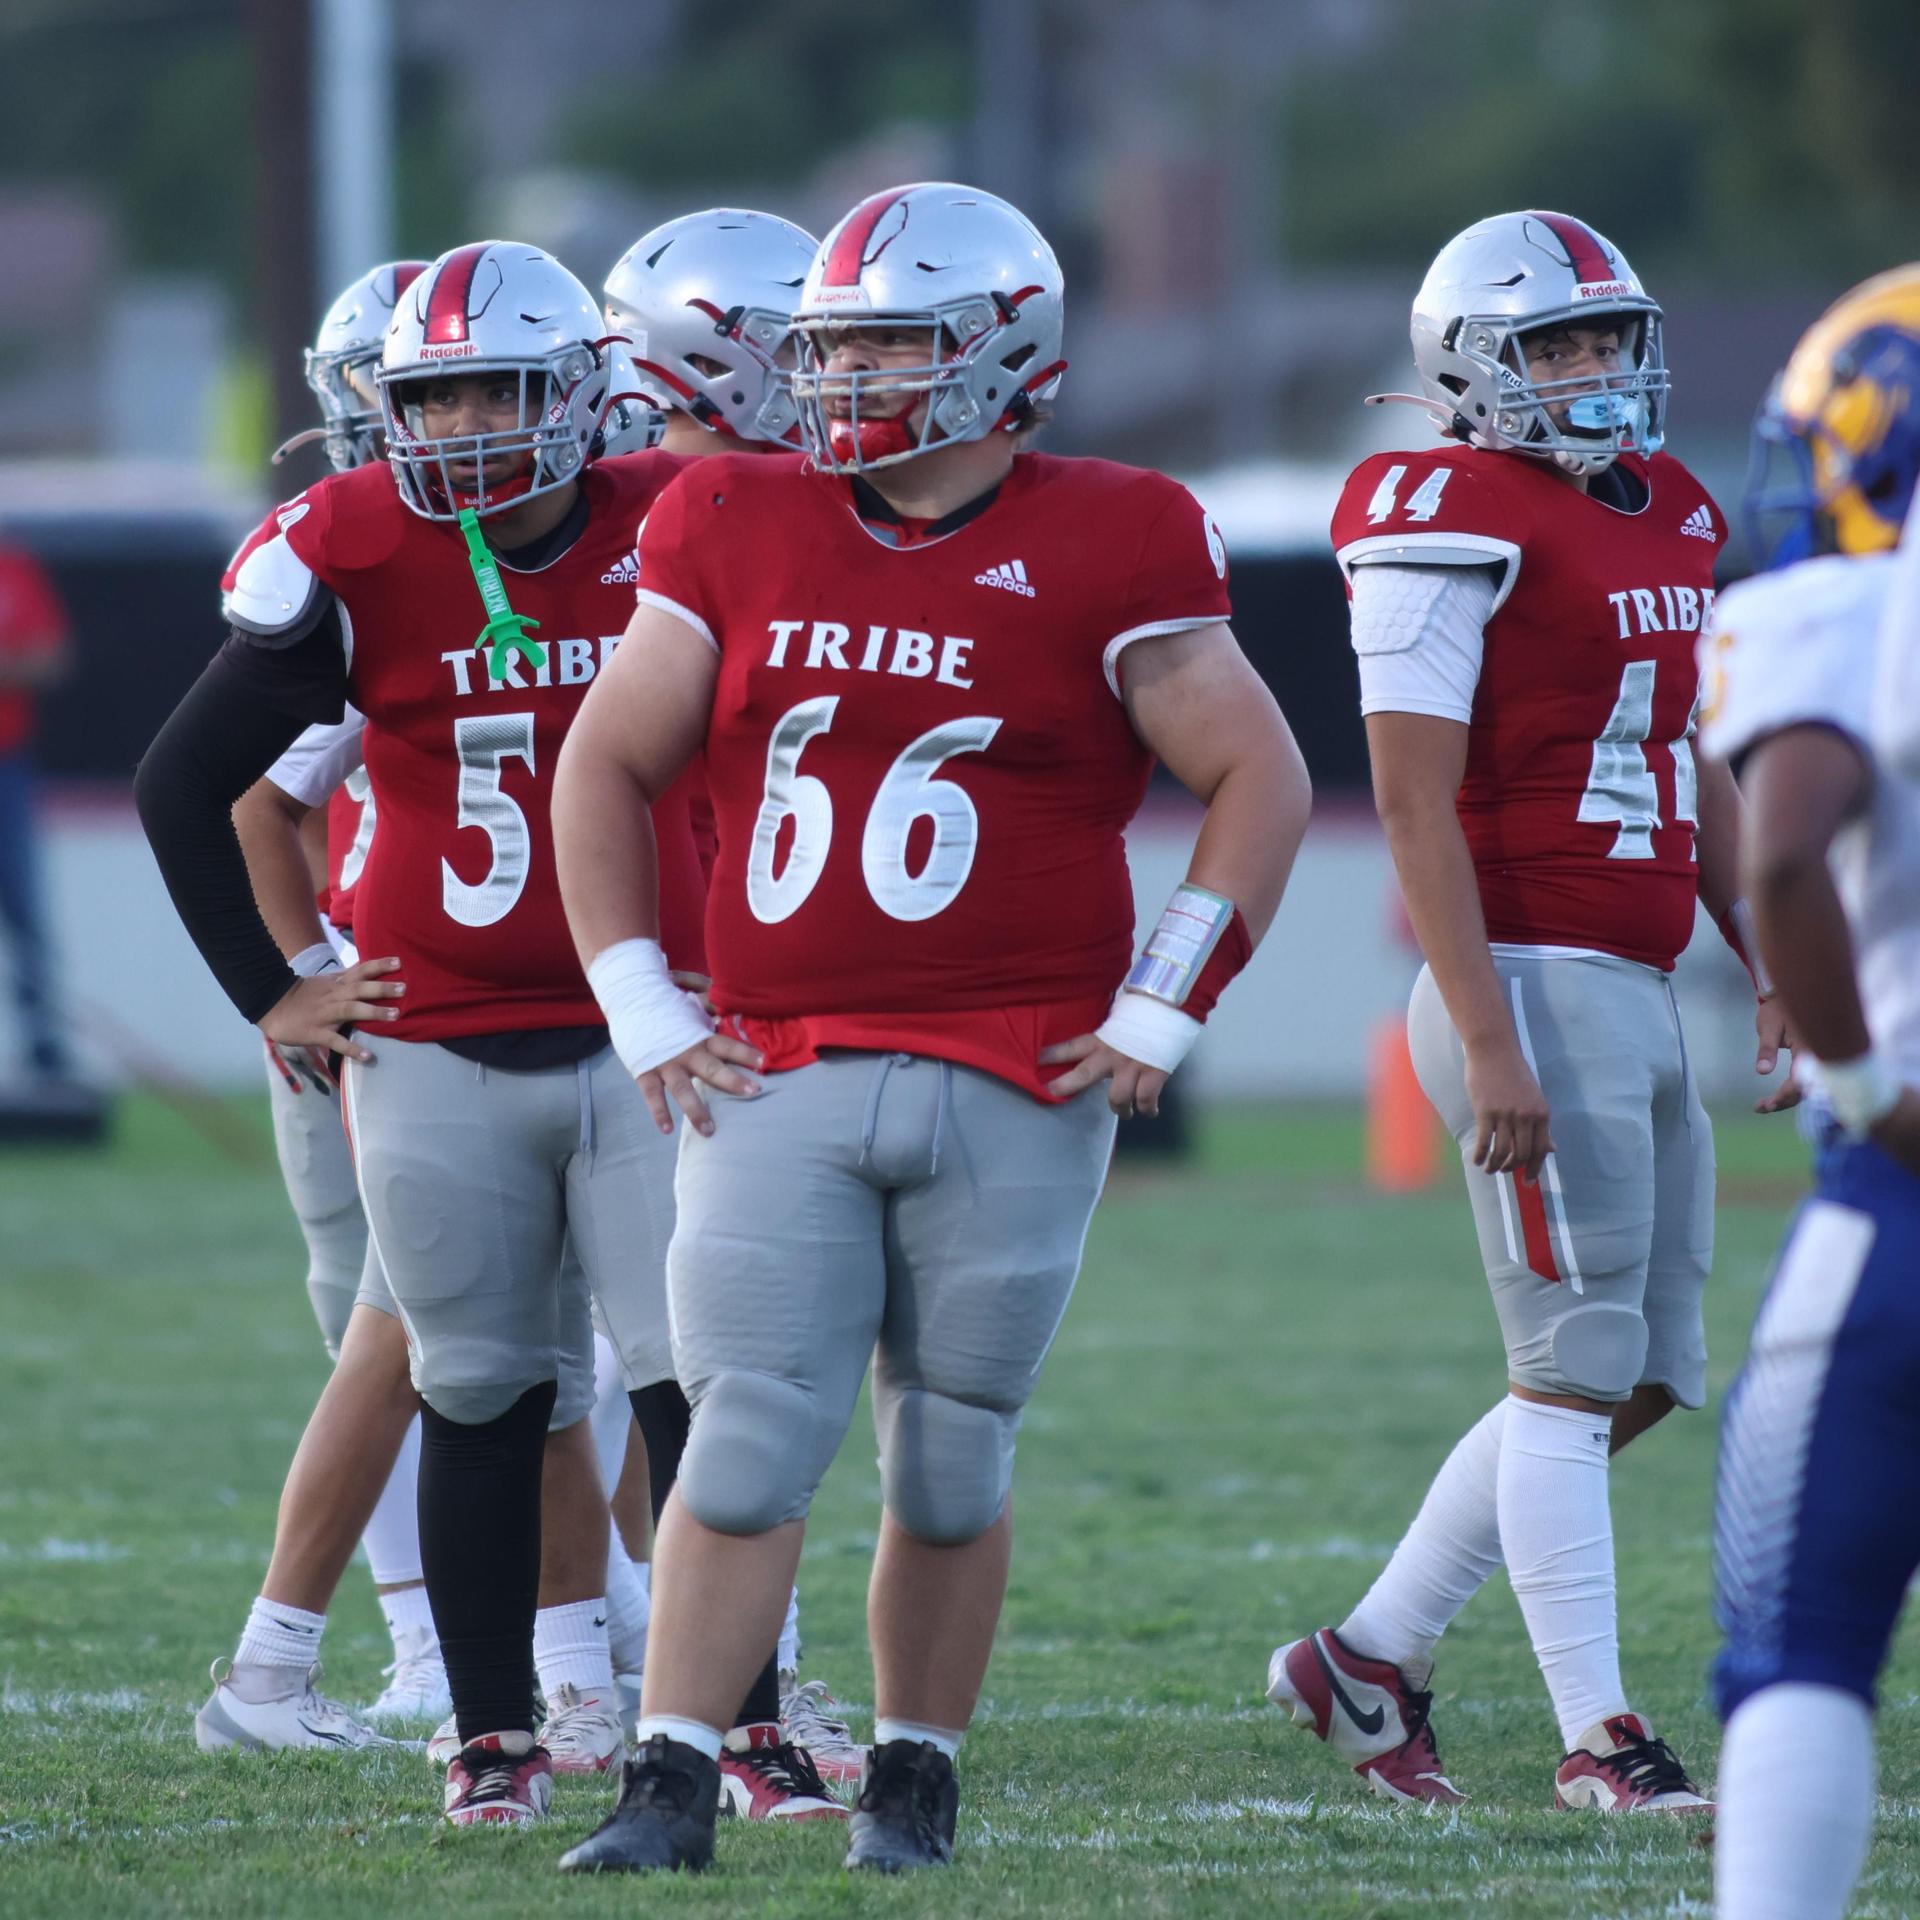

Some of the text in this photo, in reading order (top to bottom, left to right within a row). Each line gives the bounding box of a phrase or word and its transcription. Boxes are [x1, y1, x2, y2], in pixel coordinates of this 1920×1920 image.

[1581, 284, 1628, 298] Riddell
[420, 344, 473, 359] Riddell
[1366, 465, 1453, 525] 44
[1680, 524, 1716, 543] adidas
[974, 574, 1036, 598] adidas
[765, 620, 974, 689] TRIBE
[747, 695, 1003, 924] 66
